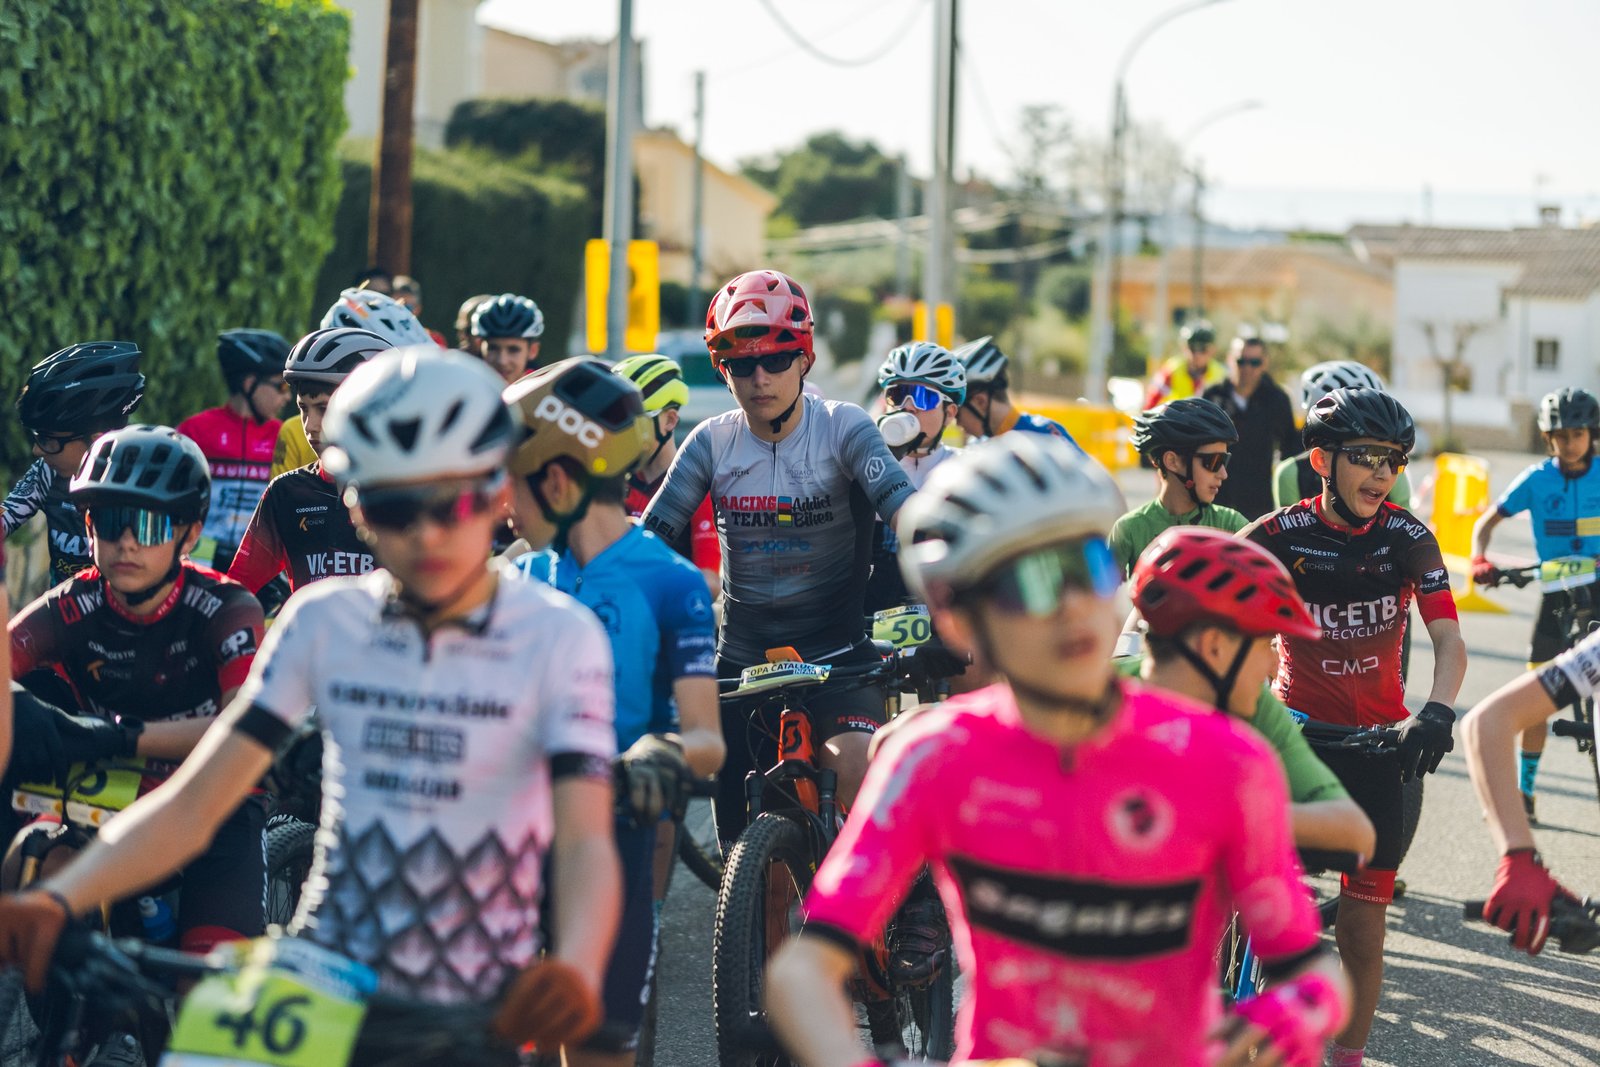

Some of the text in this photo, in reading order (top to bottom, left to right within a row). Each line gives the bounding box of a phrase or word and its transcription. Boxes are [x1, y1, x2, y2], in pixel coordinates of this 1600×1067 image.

[719, 495, 777, 512] RACING
[792, 494, 832, 513] Addict
[731, 512, 777, 527] TEAM
[306, 551, 374, 575] VIC-ETB
[891, 618, 930, 645] 50
[1321, 655, 1379, 676] CMP
